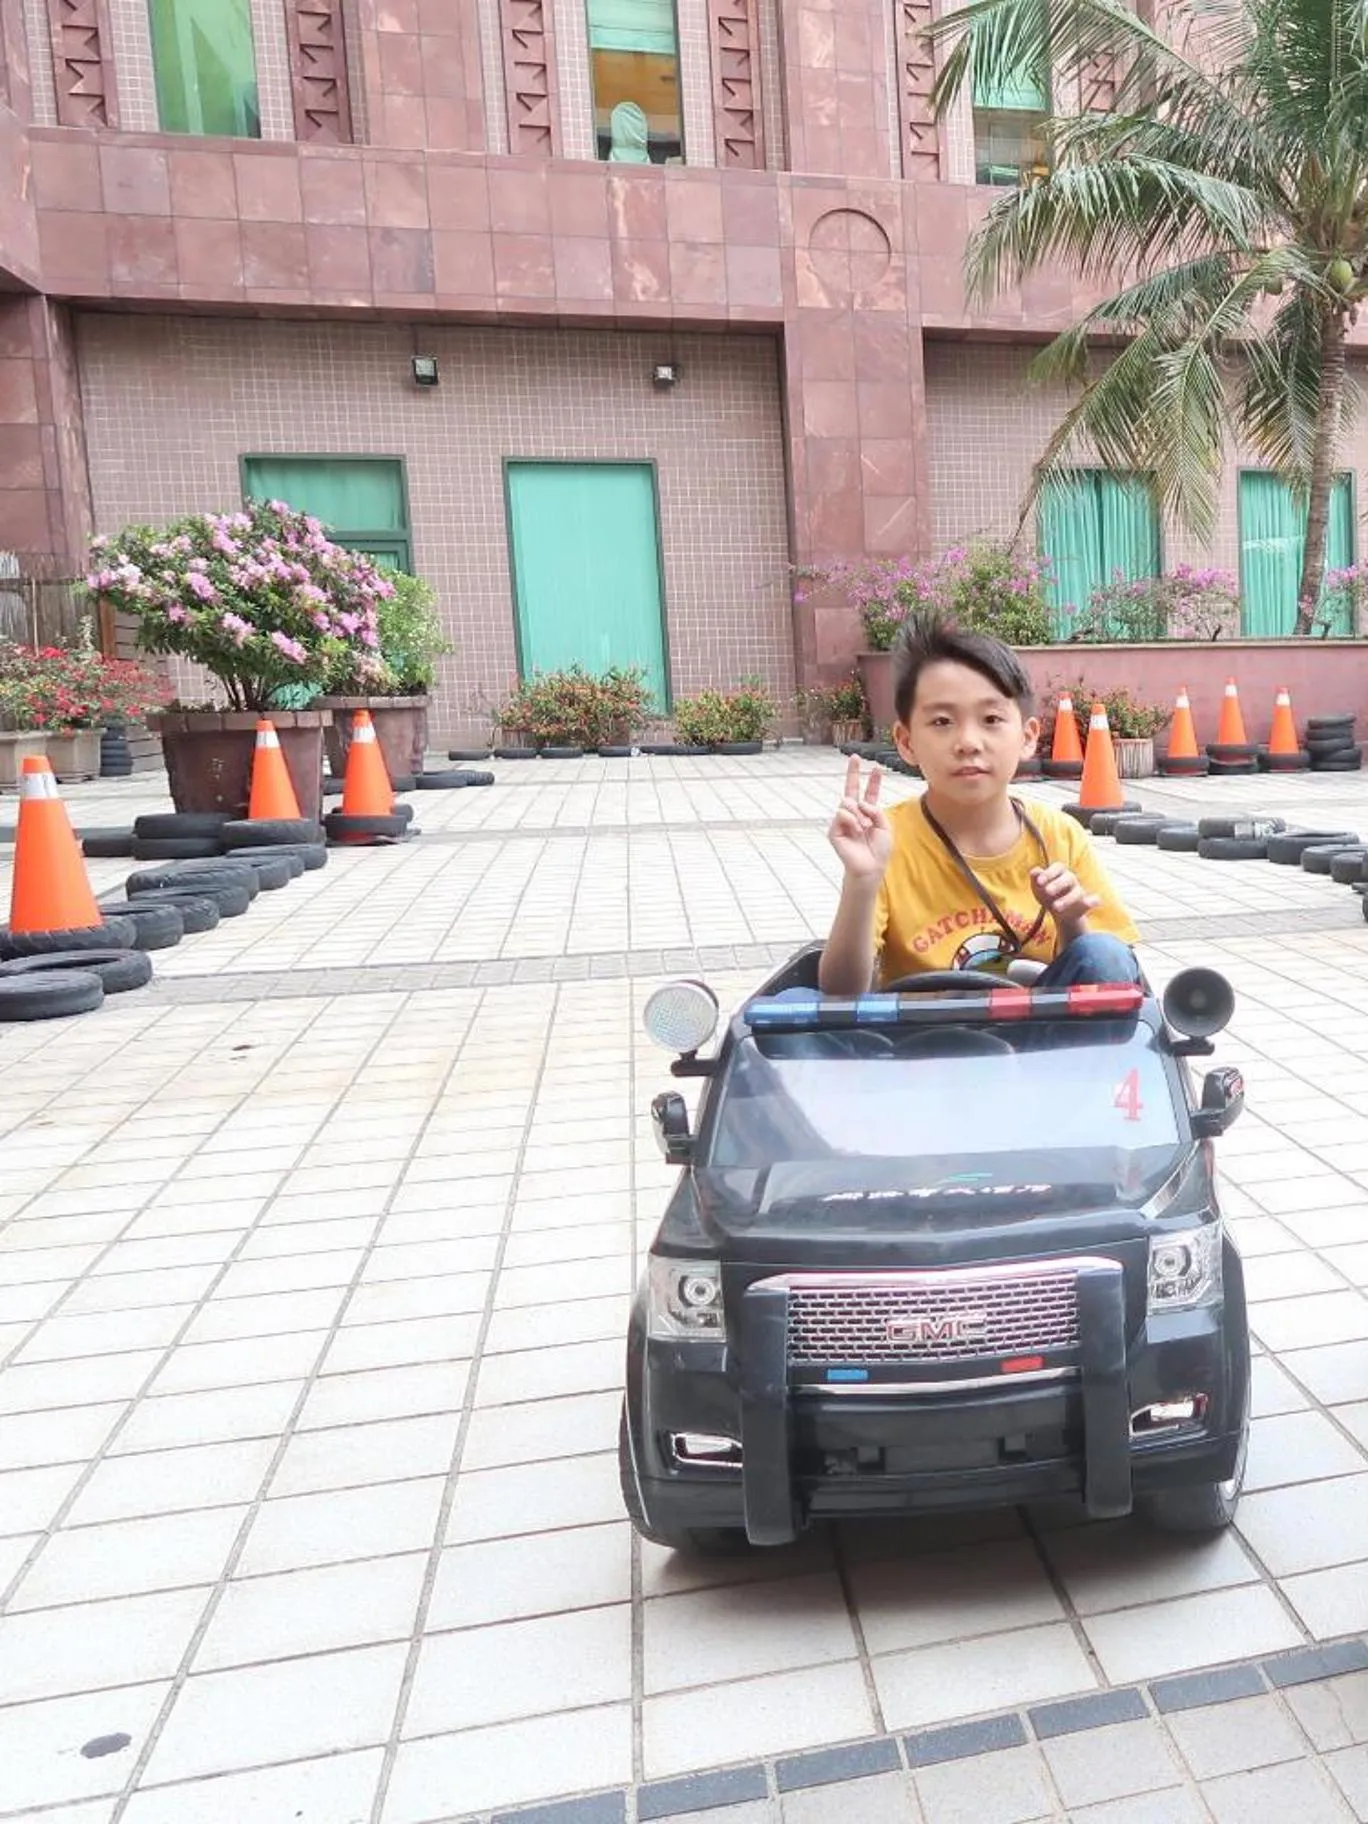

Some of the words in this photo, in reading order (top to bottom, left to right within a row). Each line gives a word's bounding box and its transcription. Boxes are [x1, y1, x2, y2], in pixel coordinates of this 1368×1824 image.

[912, 905, 1052, 953] GATCHMN
[1113, 1067, 1143, 1121] 4
[885, 1313, 988, 1342] GMC
